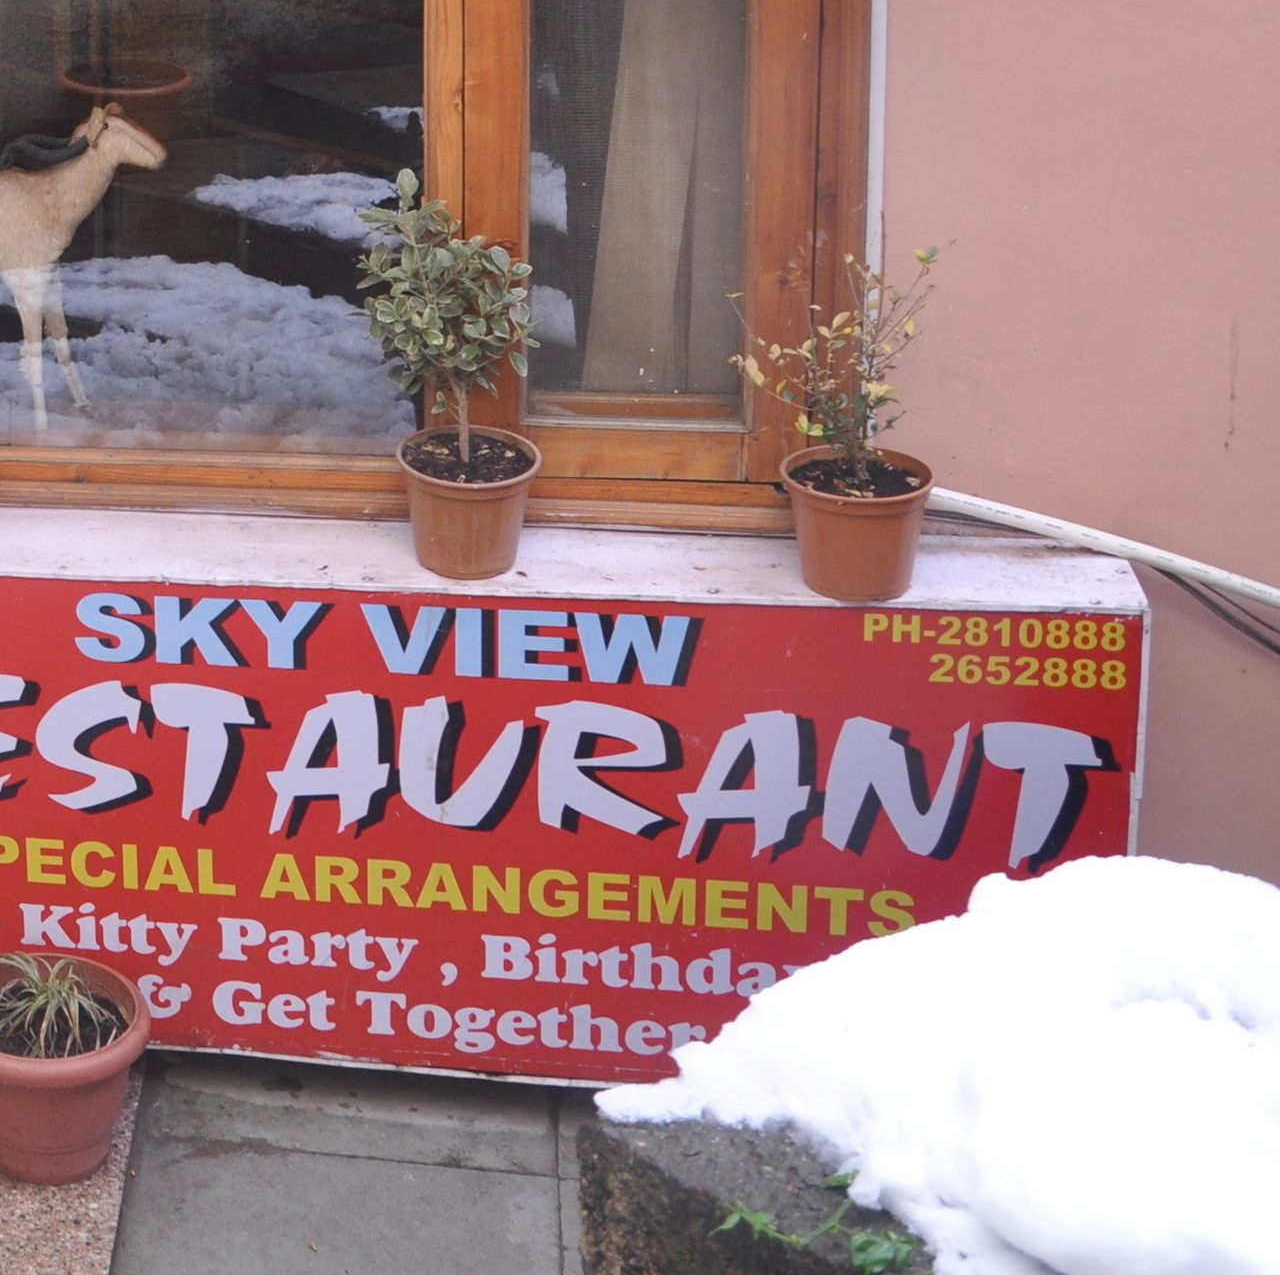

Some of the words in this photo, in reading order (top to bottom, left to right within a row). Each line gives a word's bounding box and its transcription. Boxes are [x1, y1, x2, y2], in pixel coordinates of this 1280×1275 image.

[74, 593, 323, 670] SKY
[360, 603, 692, 686] VIEW
[863, 613, 1126, 652] PH-2810888
[928, 654, 1127, 690] 2652888
[260, 853, 916, 937] ARRANGEMENTS
[20, 902, 199, 966] Kitty
[480, 932, 806, 998] Birthda
[137, 974, 192, 1020] &
[212, 980, 337, 1032] Get
[355, 989, 707, 1056] Together
